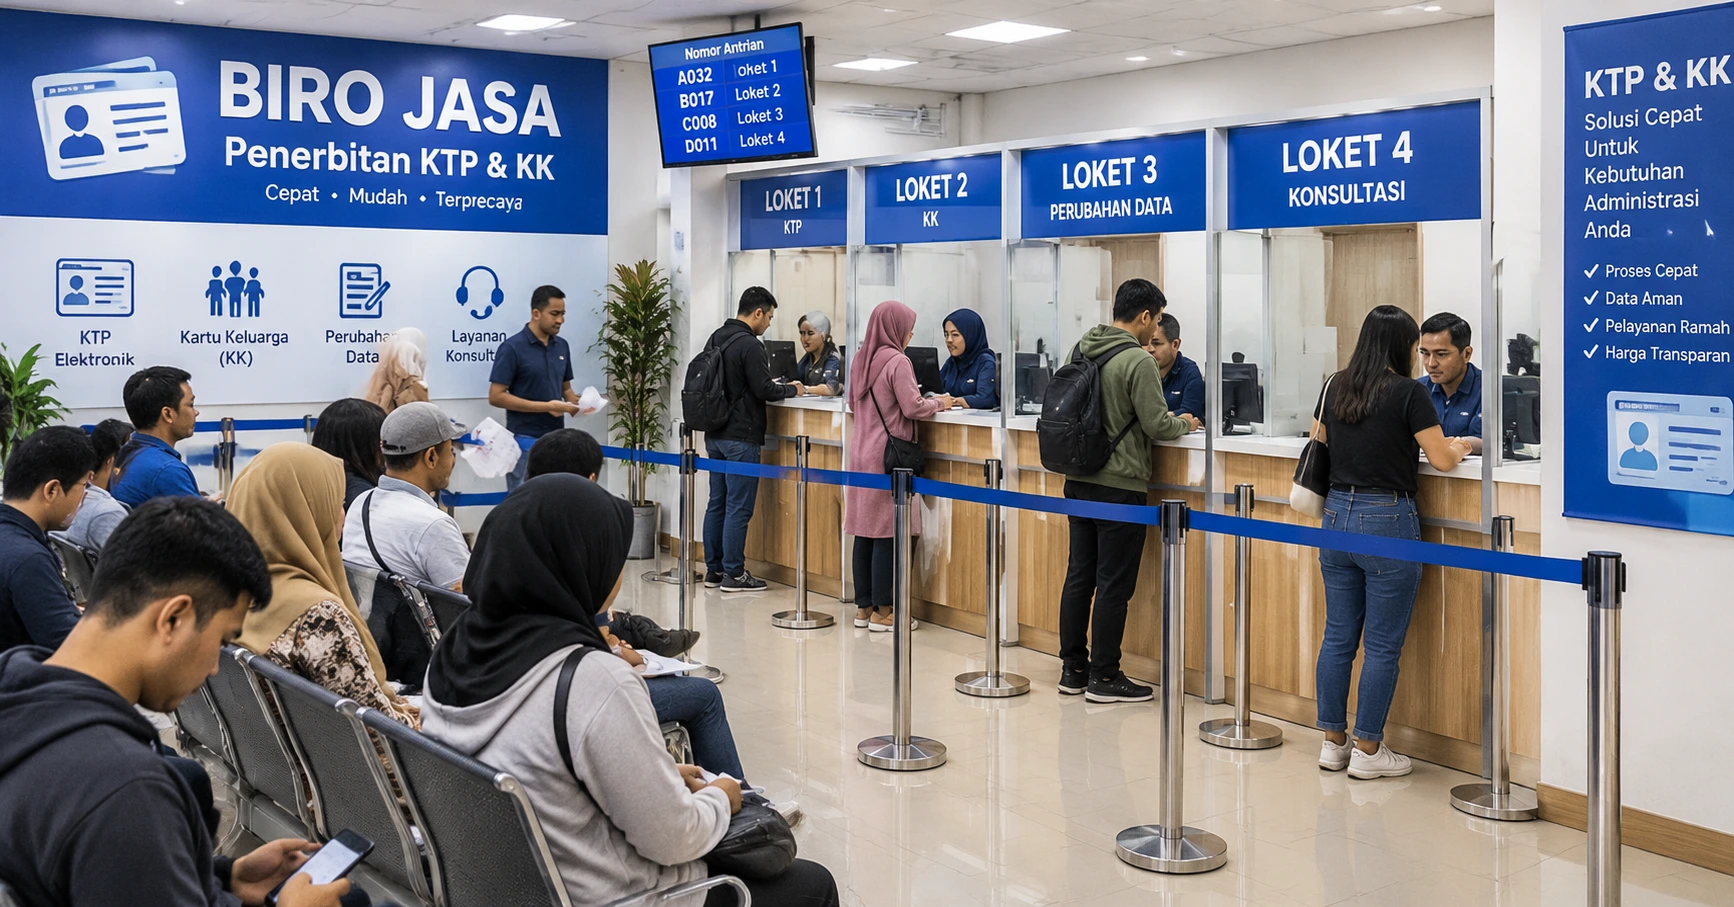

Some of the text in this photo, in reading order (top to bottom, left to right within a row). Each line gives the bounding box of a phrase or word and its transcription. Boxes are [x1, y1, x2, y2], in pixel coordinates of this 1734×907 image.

[685, 40, 764, 60] Nomor Antrian
[678, 67, 712, 85] A032
[771, 60, 776, 72] 1
[1586, 55, 1731, 98] KTP & KK
[220, 61, 561, 137] BIRO JASA
[680, 84, 780, 108] B017 Loket 2
[683, 108, 783, 131] C008 Loket 3
[1585, 104, 1702, 130] Solusi Cepat
[685, 131, 785, 153] D011 Loket 4
[1283, 131, 1413, 173] LOKET 4
[1586, 137, 1638, 157] Untuk
[226, 136, 554, 180] Penerbitan KTP & KK
[1063, 155, 1157, 189] LOKET 3
[1585, 163, 1683, 184] Kebutuhan
[897, 172, 967, 201] LOKET 2
[1289, 180, 1405, 207] KONSULTASI
[266, 184, 522, 213] Cepat Mudah Terprecaya
[766, 186, 820, 211] LOKET 1
[1051, 196, 1172, 220] PERUBAHAN DATA
[1584, 189, 1698, 211] Administrasi
[784, 220, 802, 234] KTP
[924, 211, 938, 227] KK
[1584, 221, 1630, 238] Anda
[1606, 264, 1698, 280] Proses Cepat
[1606, 292, 1682, 305] Data Aman
[81, 330, 110, 344] KTP
[325, 329, 398, 343] Perubaha
[452, 329, 507, 346] Layanan
[1606, 319, 1729, 336] Pelayanan Ramah
[181, 330, 288, 346] Kartu Keluarga
[56, 353, 134, 366] Elektronik
[220, 351, 252, 368] (KK)
[347, 350, 379, 363] Data
[446, 348, 495, 362] Konsult
[1606, 346, 1730, 364] Harga Transparan
